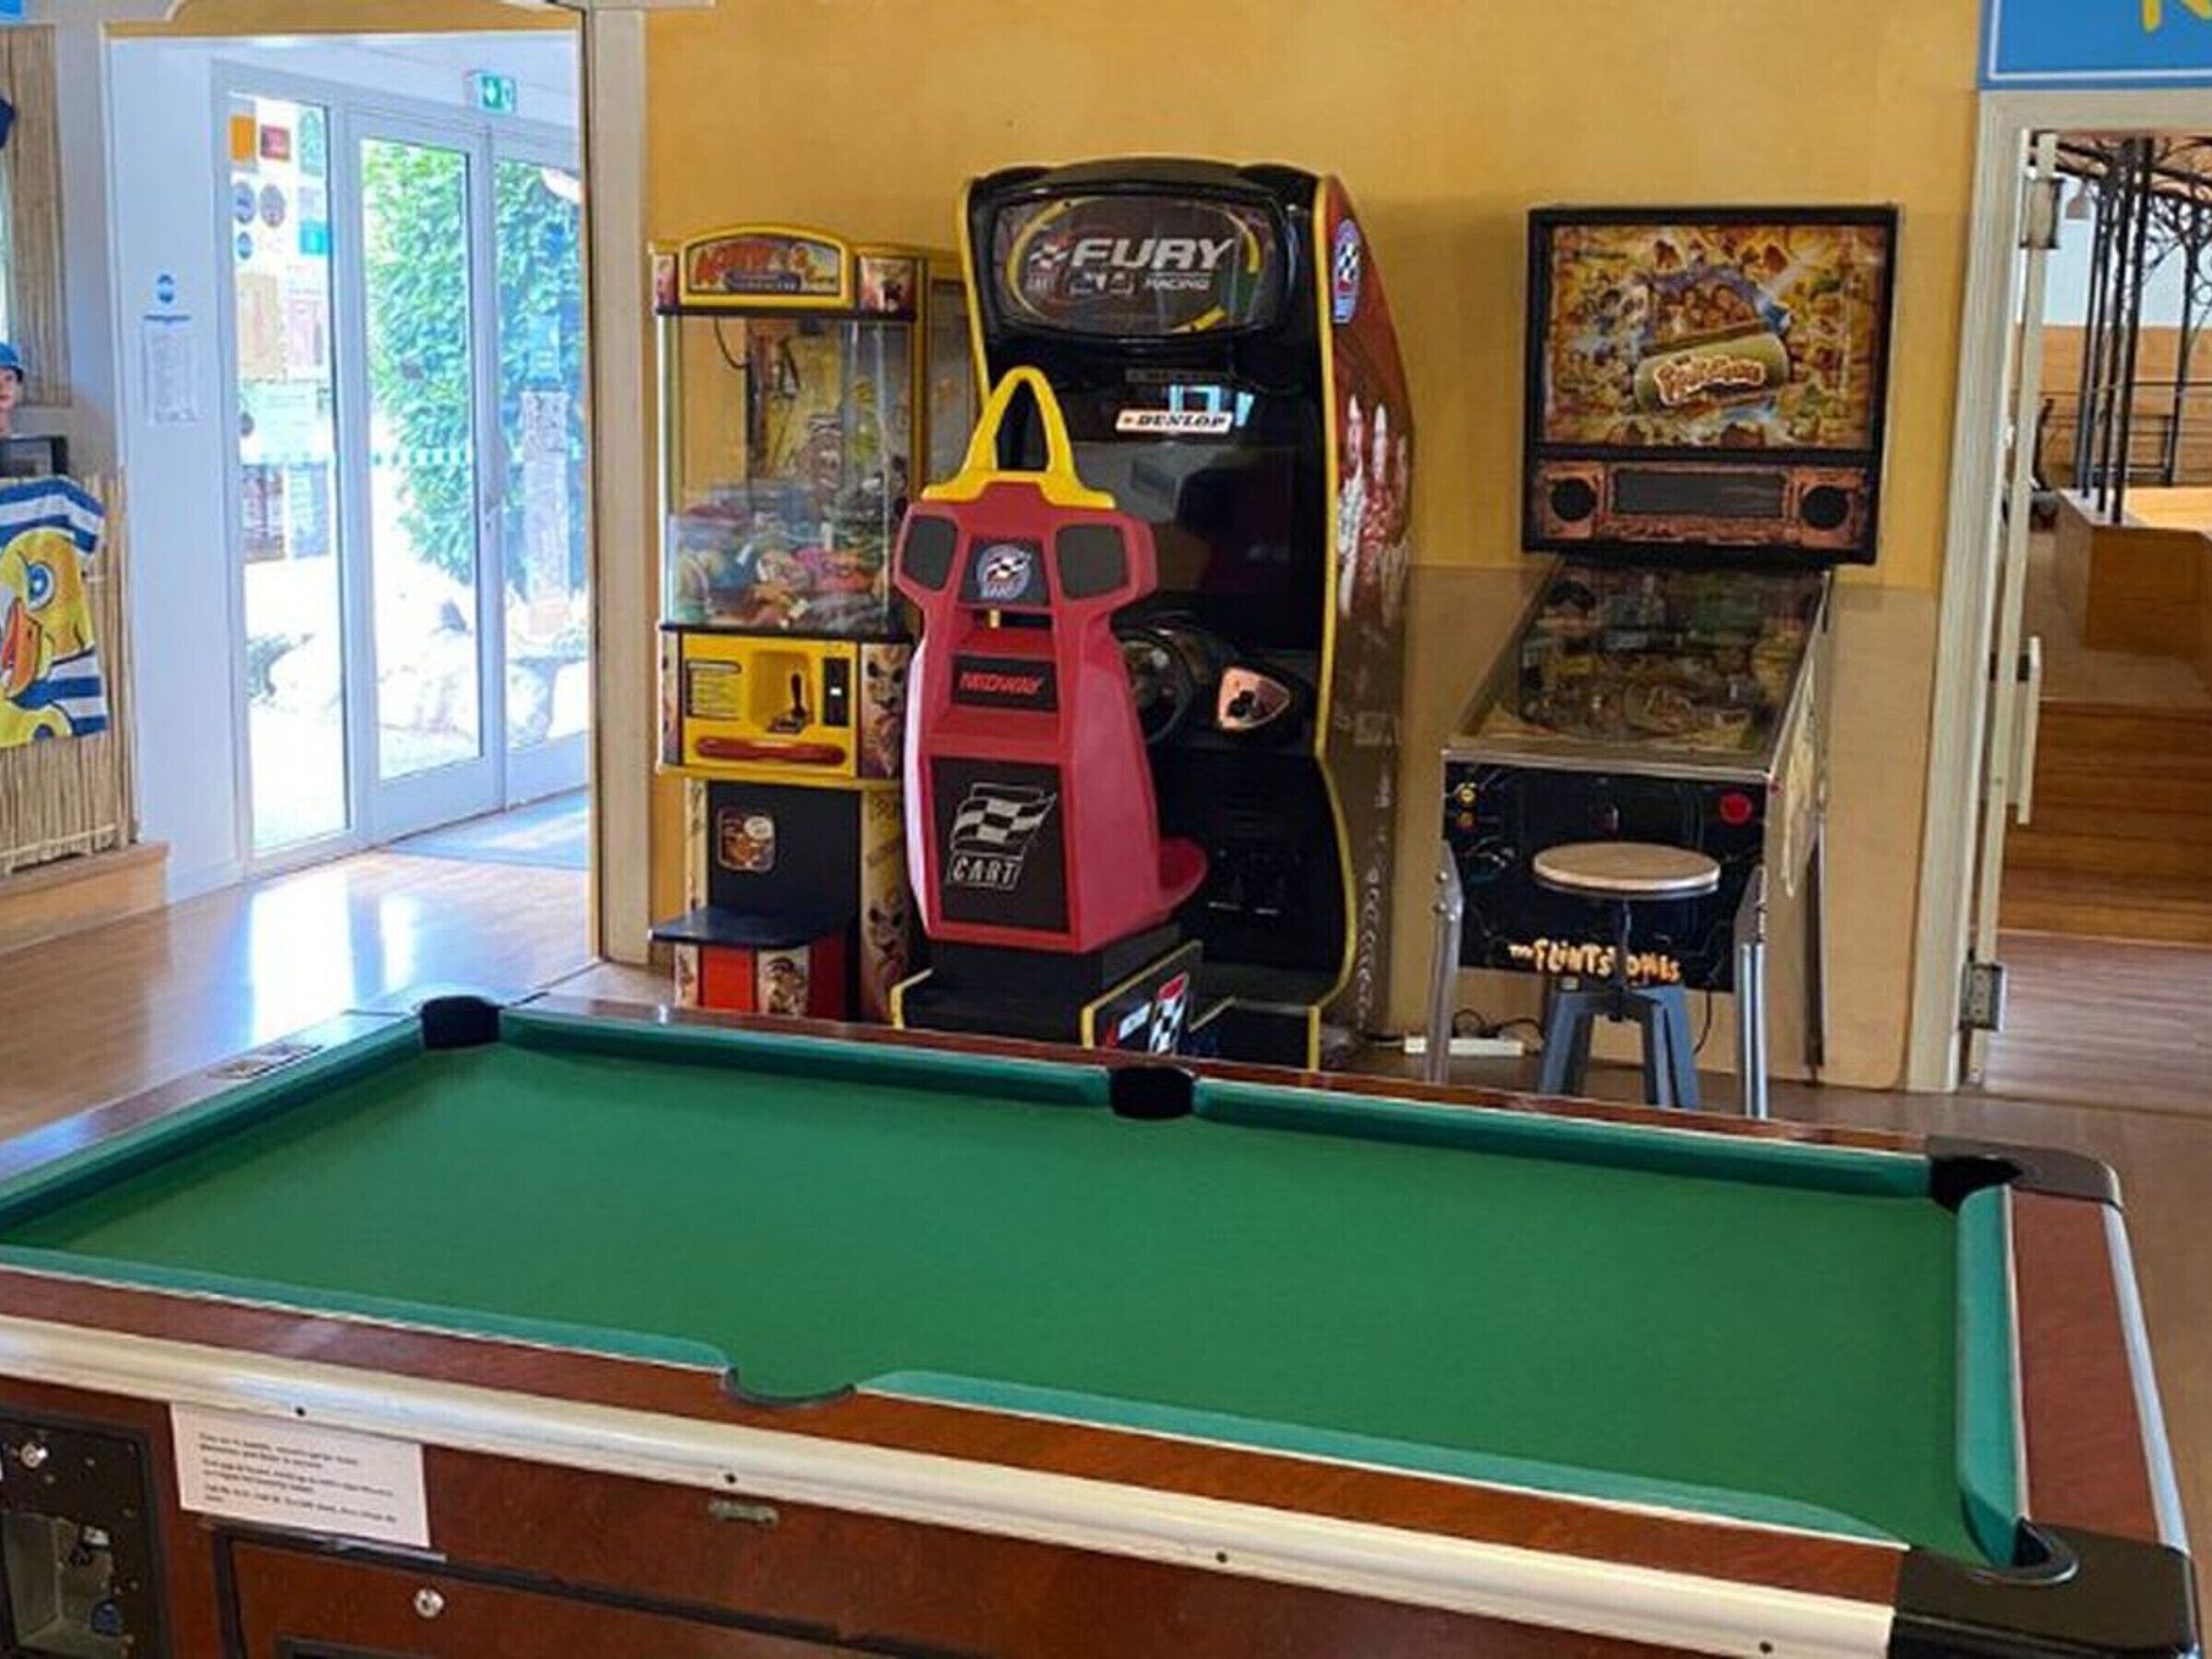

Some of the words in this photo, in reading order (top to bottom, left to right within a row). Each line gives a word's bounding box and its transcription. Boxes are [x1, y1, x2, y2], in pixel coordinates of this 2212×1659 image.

[1072, 237, 1235, 269] FURY
[1136, 413, 1228, 427] DUNLOP
[952, 855, 1017, 884] CART
